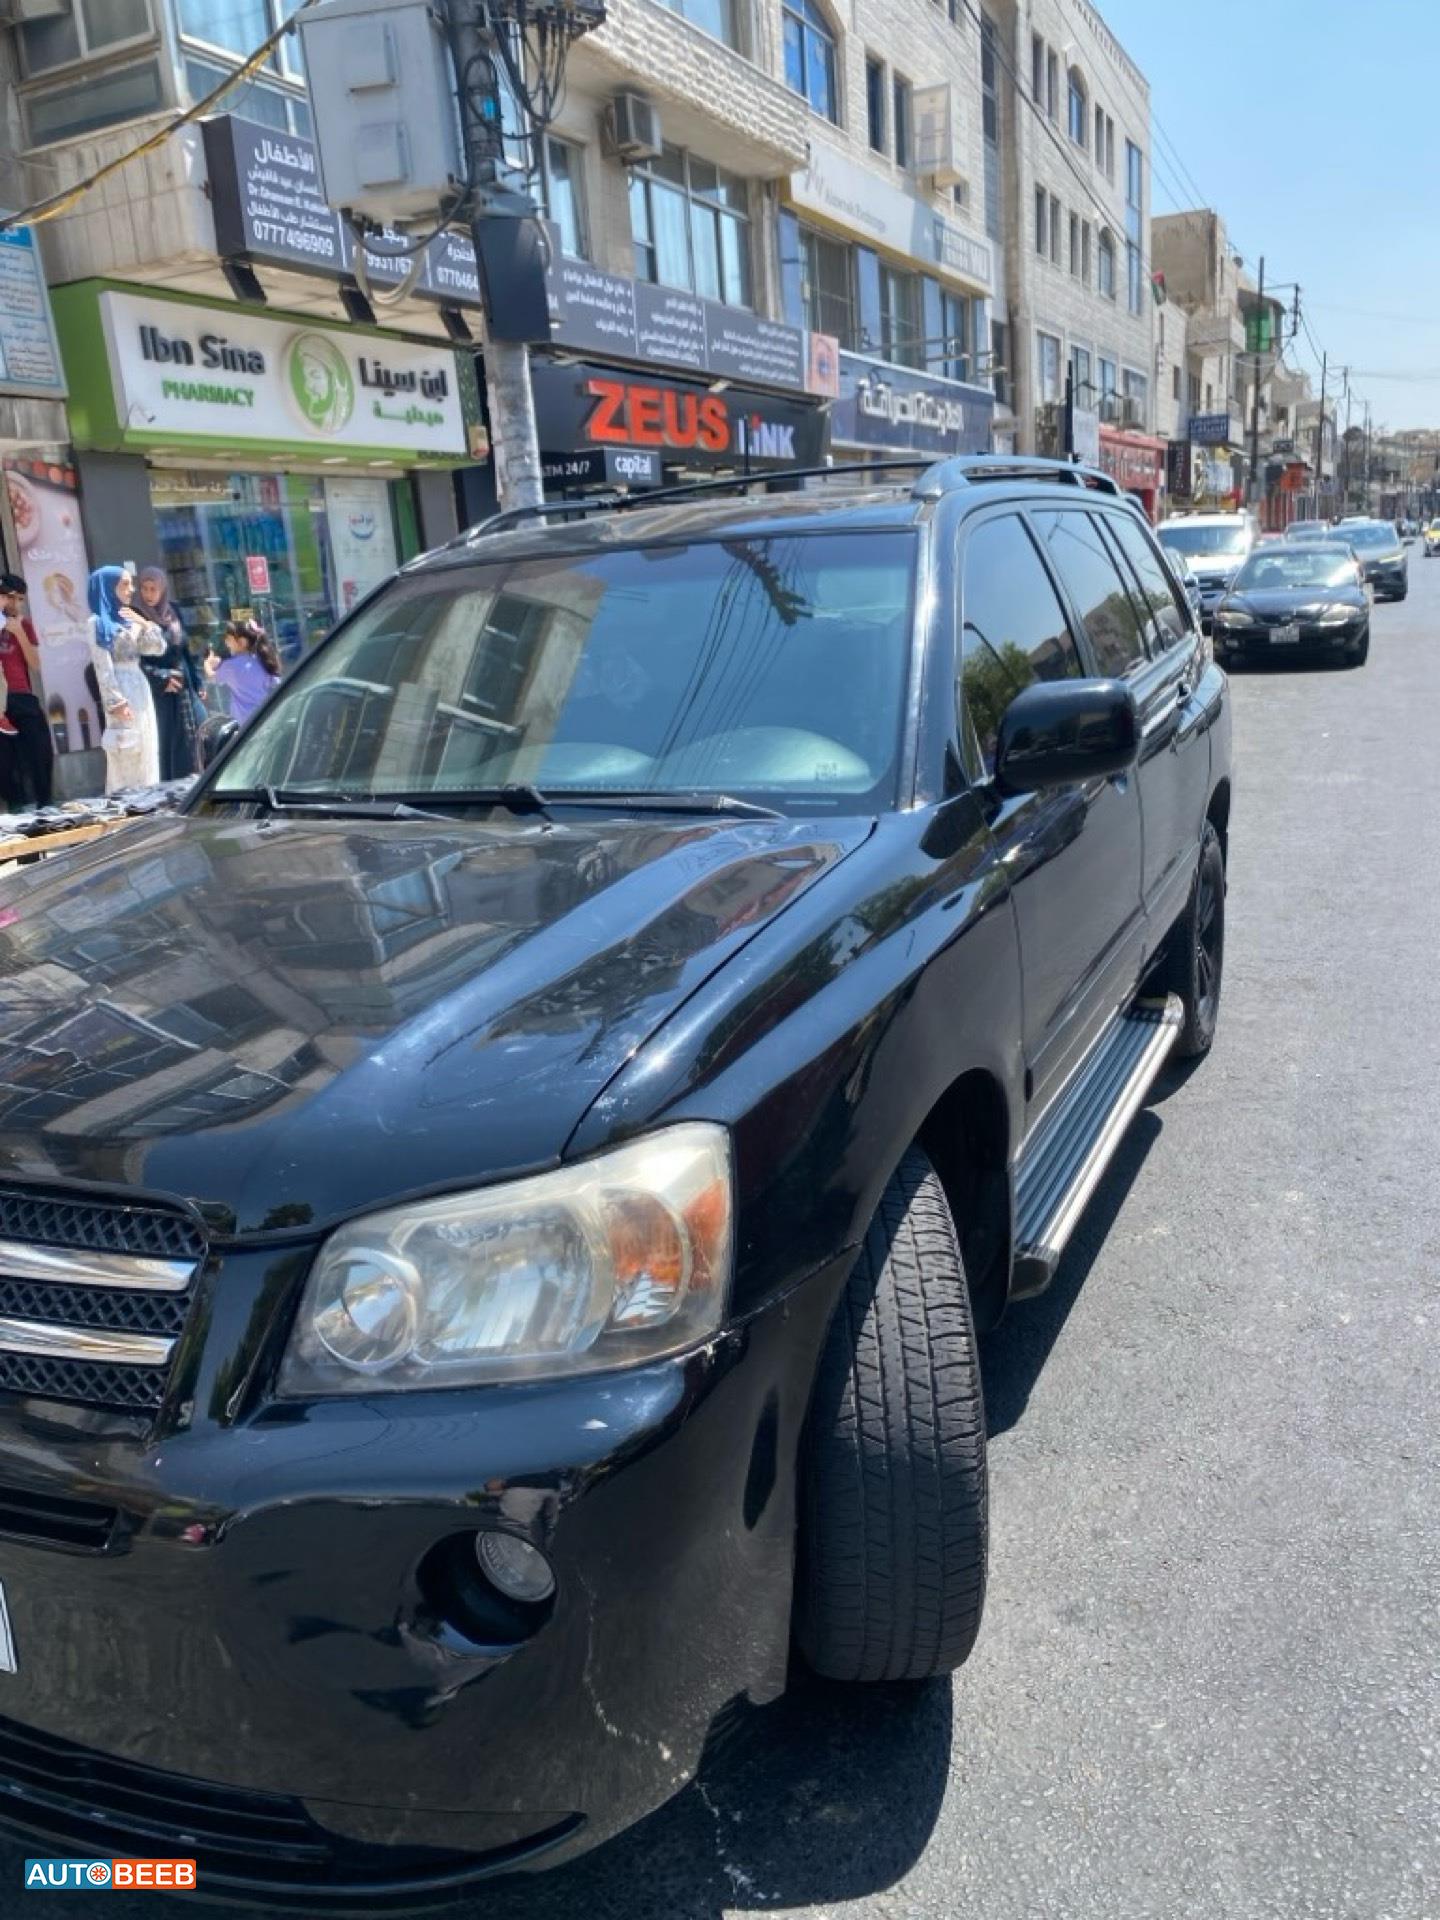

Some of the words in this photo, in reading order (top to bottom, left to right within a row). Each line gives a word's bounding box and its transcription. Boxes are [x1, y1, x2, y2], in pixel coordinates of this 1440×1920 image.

[138, 324, 194, 366] Ibn
[199, 334, 266, 374] Sina
[161, 379, 254, 408] PHARMACY
[358, 356, 417, 397] سينا
[420, 368, 449, 403] ابن
[586, 379, 730, 453] ZEUS
[565, 458, 591, 476] 24/7
[614, 455, 651, 479] capital
